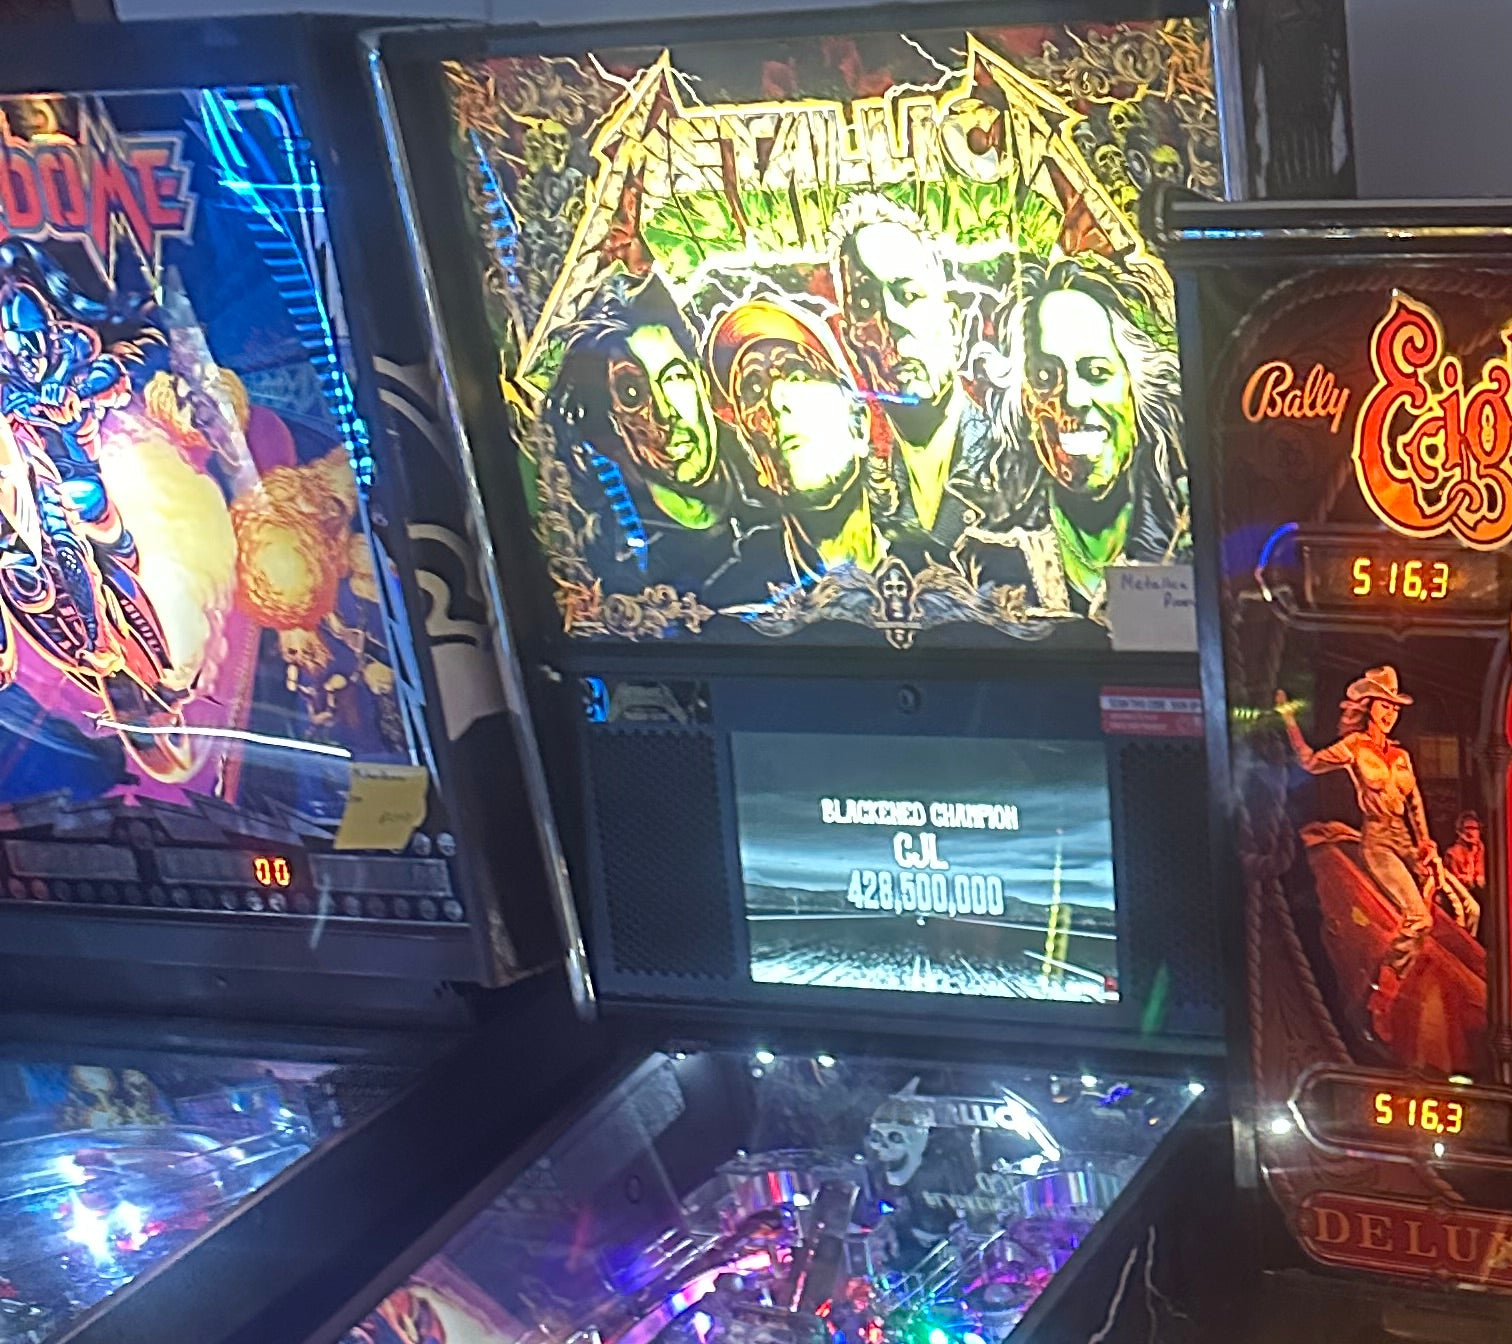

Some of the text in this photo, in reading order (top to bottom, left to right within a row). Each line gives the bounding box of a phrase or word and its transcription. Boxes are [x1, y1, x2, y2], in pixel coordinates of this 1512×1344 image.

[0, 145, 186, 255] DOME
[1242, 360, 1350, 433] Bally
[820, 798, 1019, 830] BLACKENED CHAMPION
[254, 856, 291, 887] 00
[893, 831, 949, 871] CJL
[847, 869, 1004, 917] 428,500,000
